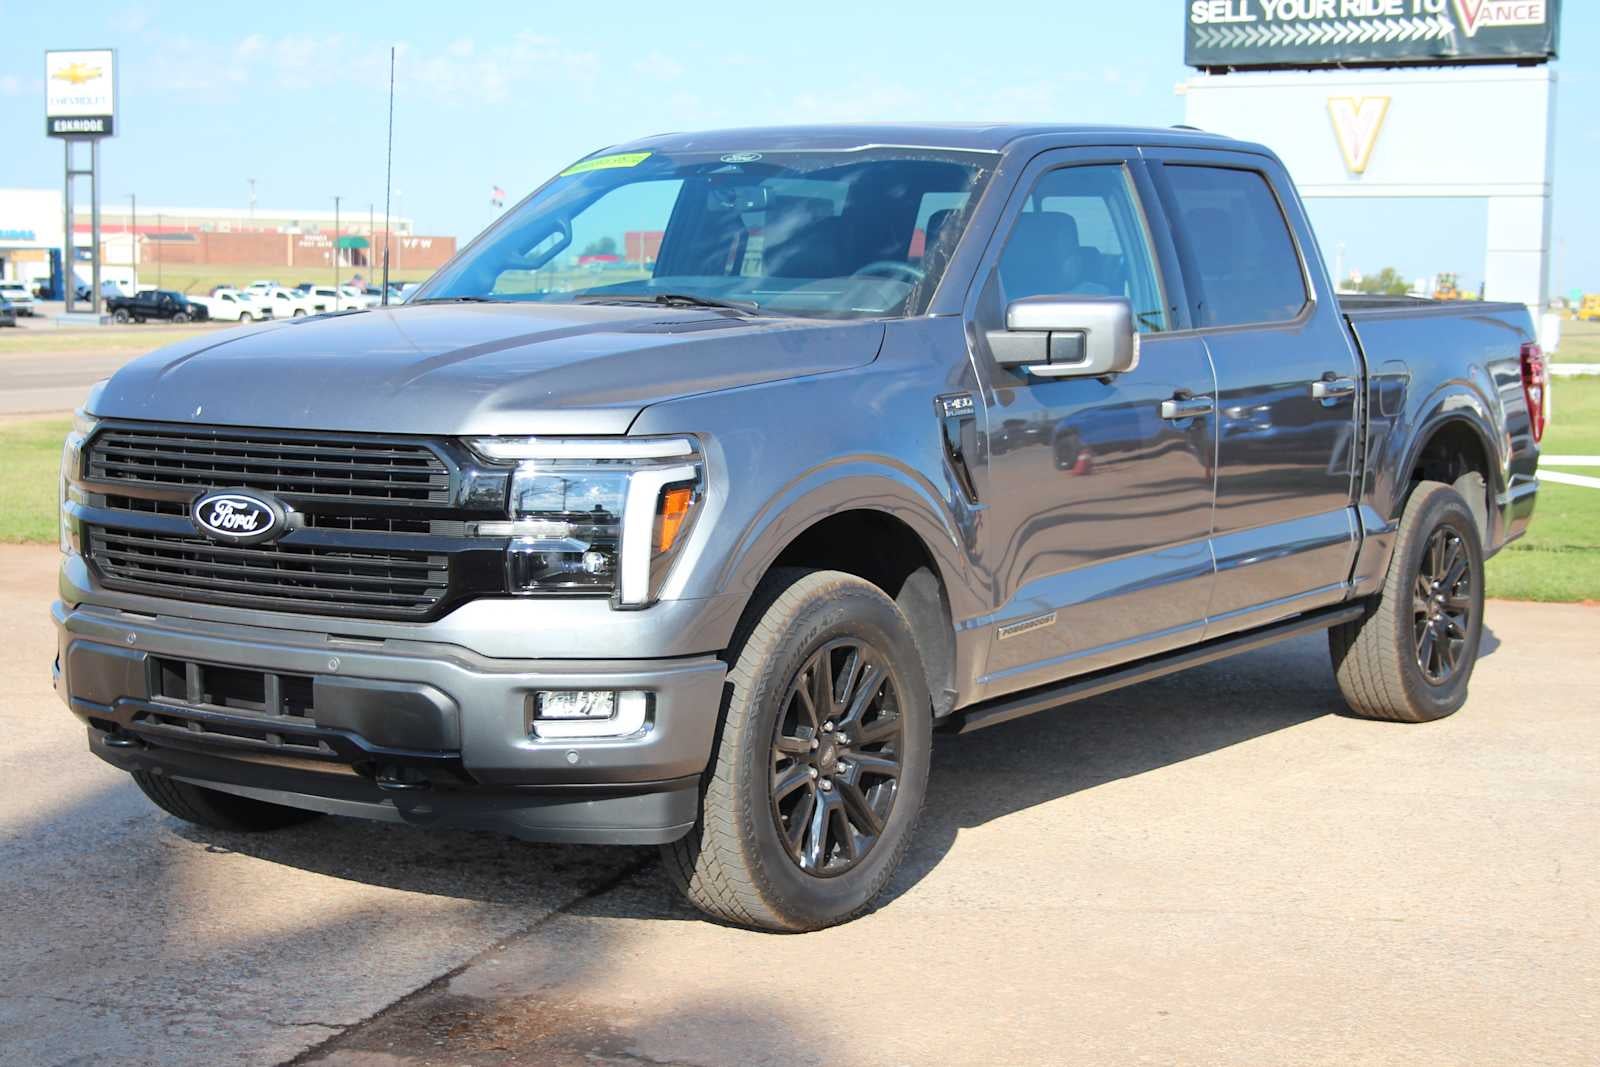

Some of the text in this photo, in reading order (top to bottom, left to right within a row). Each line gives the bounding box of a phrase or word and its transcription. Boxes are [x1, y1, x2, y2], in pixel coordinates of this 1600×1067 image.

[1191, 0, 1257, 24] SELL
[1260, 0, 1337, 20] YOUR
[1340, 0, 1404, 18] RIDE
[1457, 0, 1542, 33] VANCE
[210, 500, 259, 530] Ford
